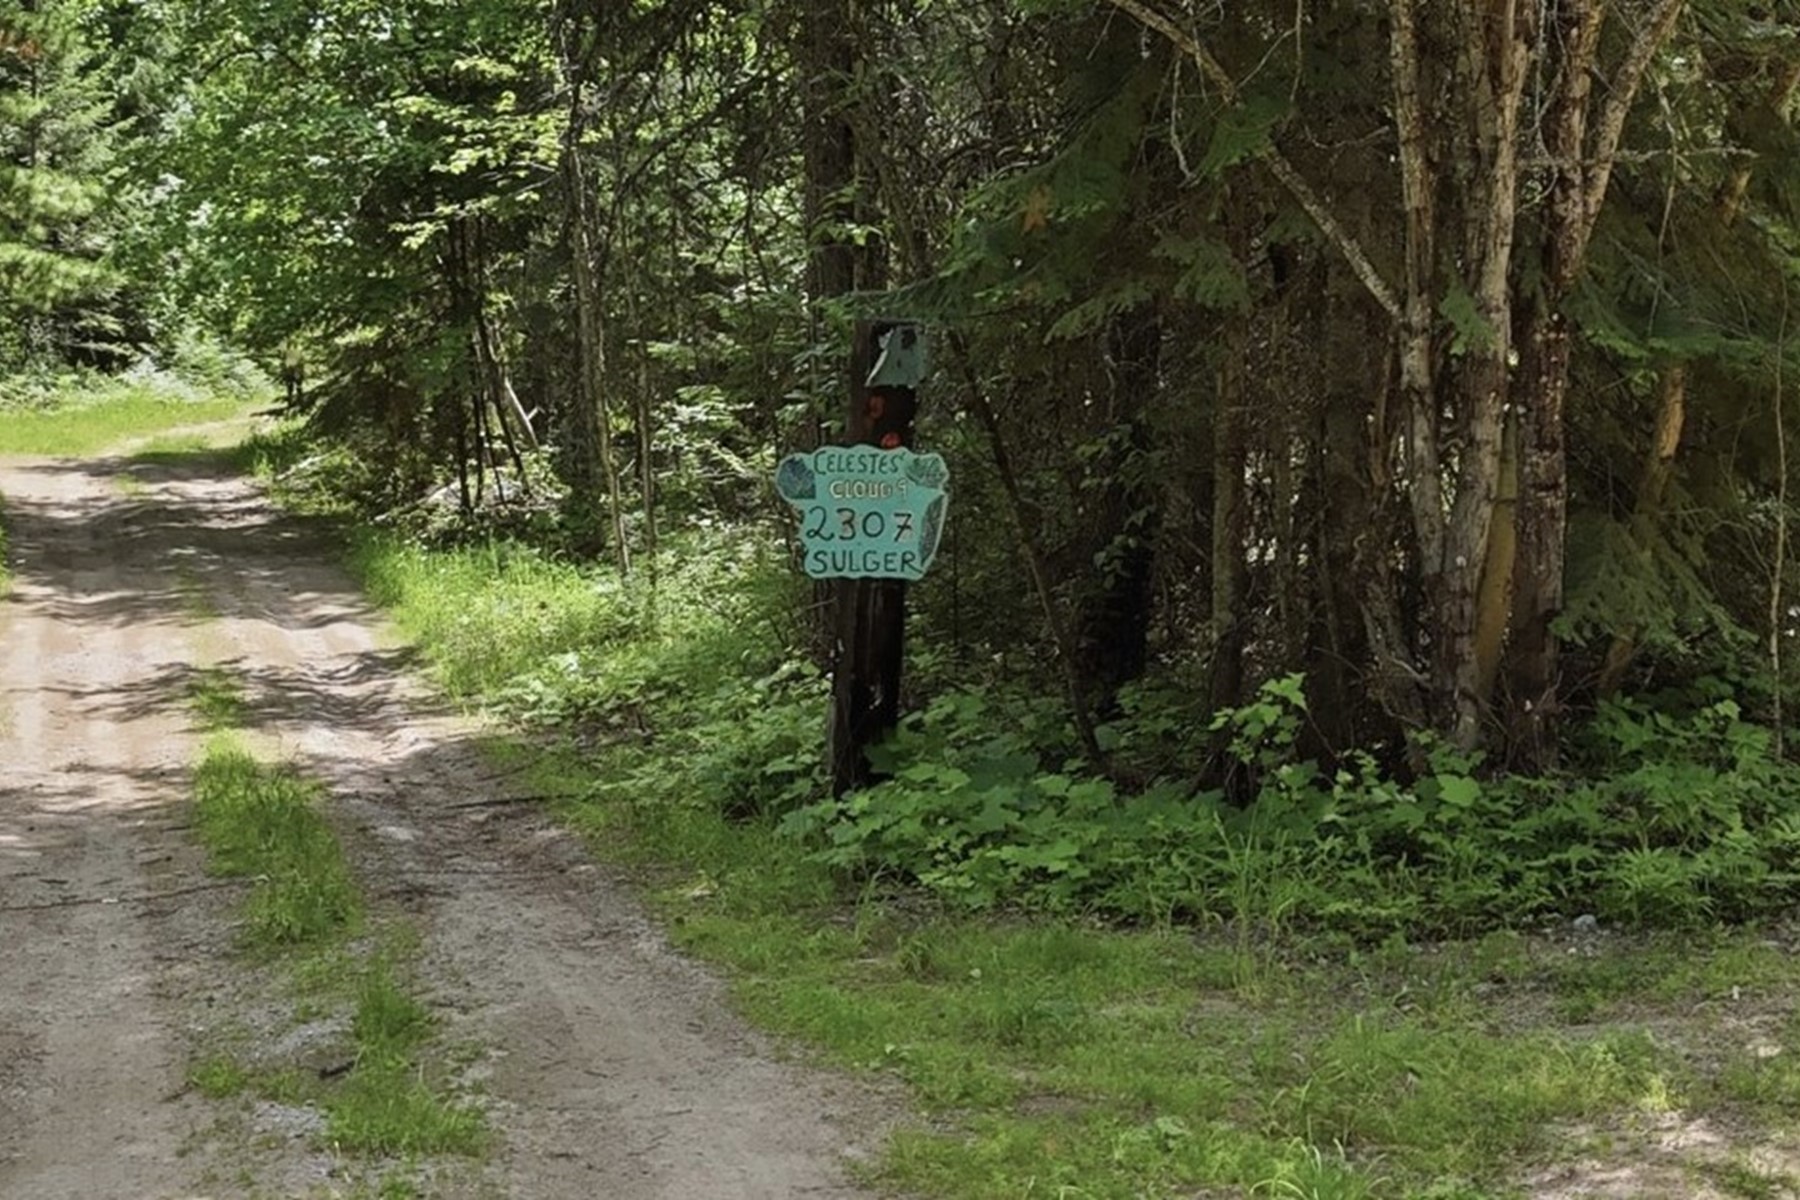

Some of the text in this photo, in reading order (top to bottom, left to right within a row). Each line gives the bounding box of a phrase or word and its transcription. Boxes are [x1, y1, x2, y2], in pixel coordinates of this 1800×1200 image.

[829, 480, 893, 499] CLOUD
[806, 505, 913, 542] 2307
[810, 550, 922, 574] SULGER
